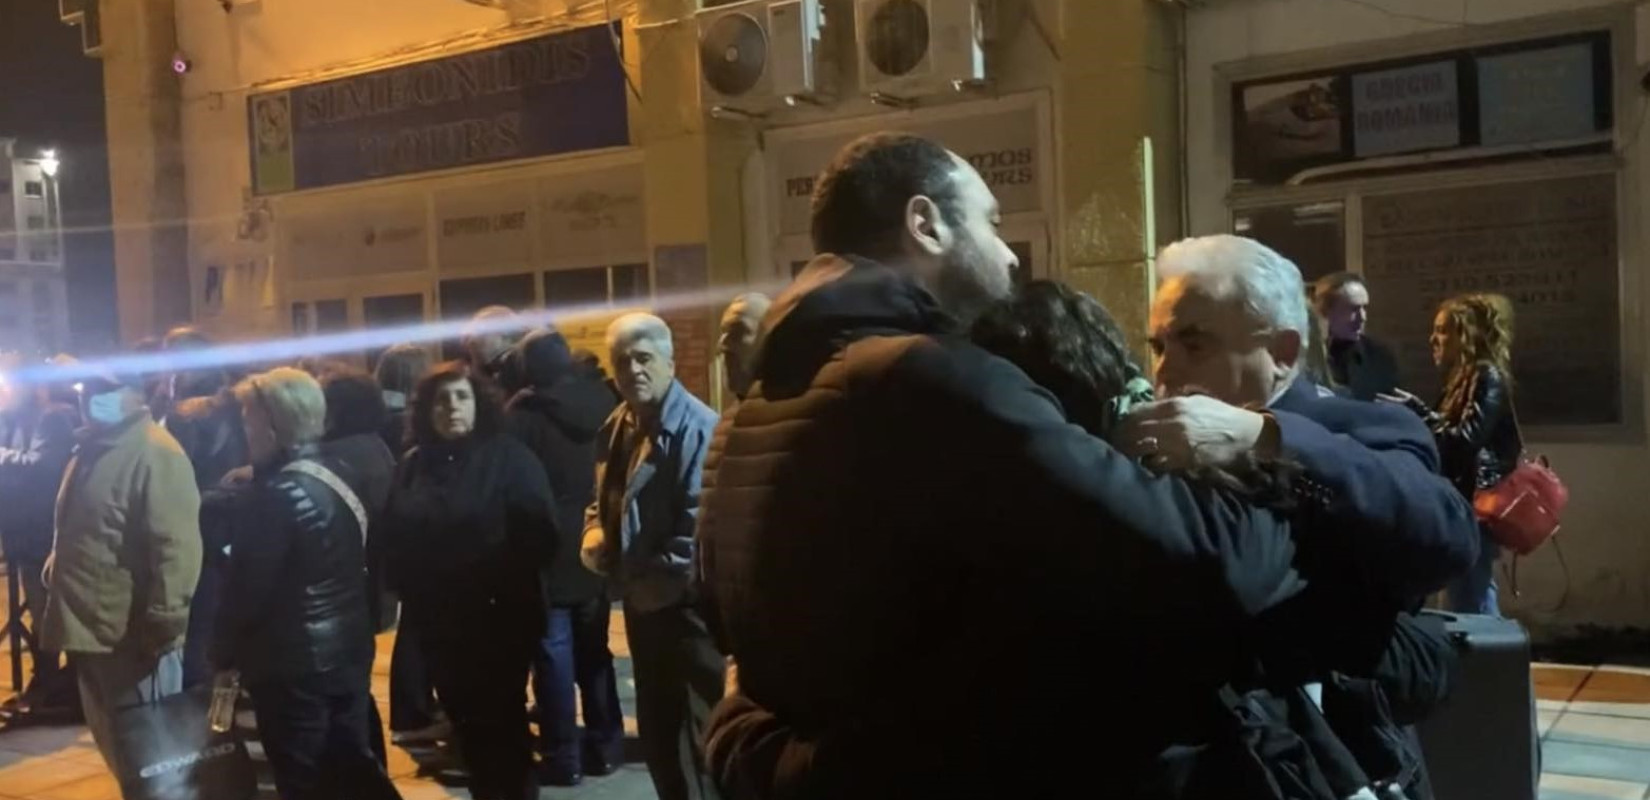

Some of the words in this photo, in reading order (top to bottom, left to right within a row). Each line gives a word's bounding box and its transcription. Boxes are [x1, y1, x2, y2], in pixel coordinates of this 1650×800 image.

[358, 111, 523, 176] TOURS
[968, 147, 1032, 168] MOS
[786, 177, 813, 196] PER
